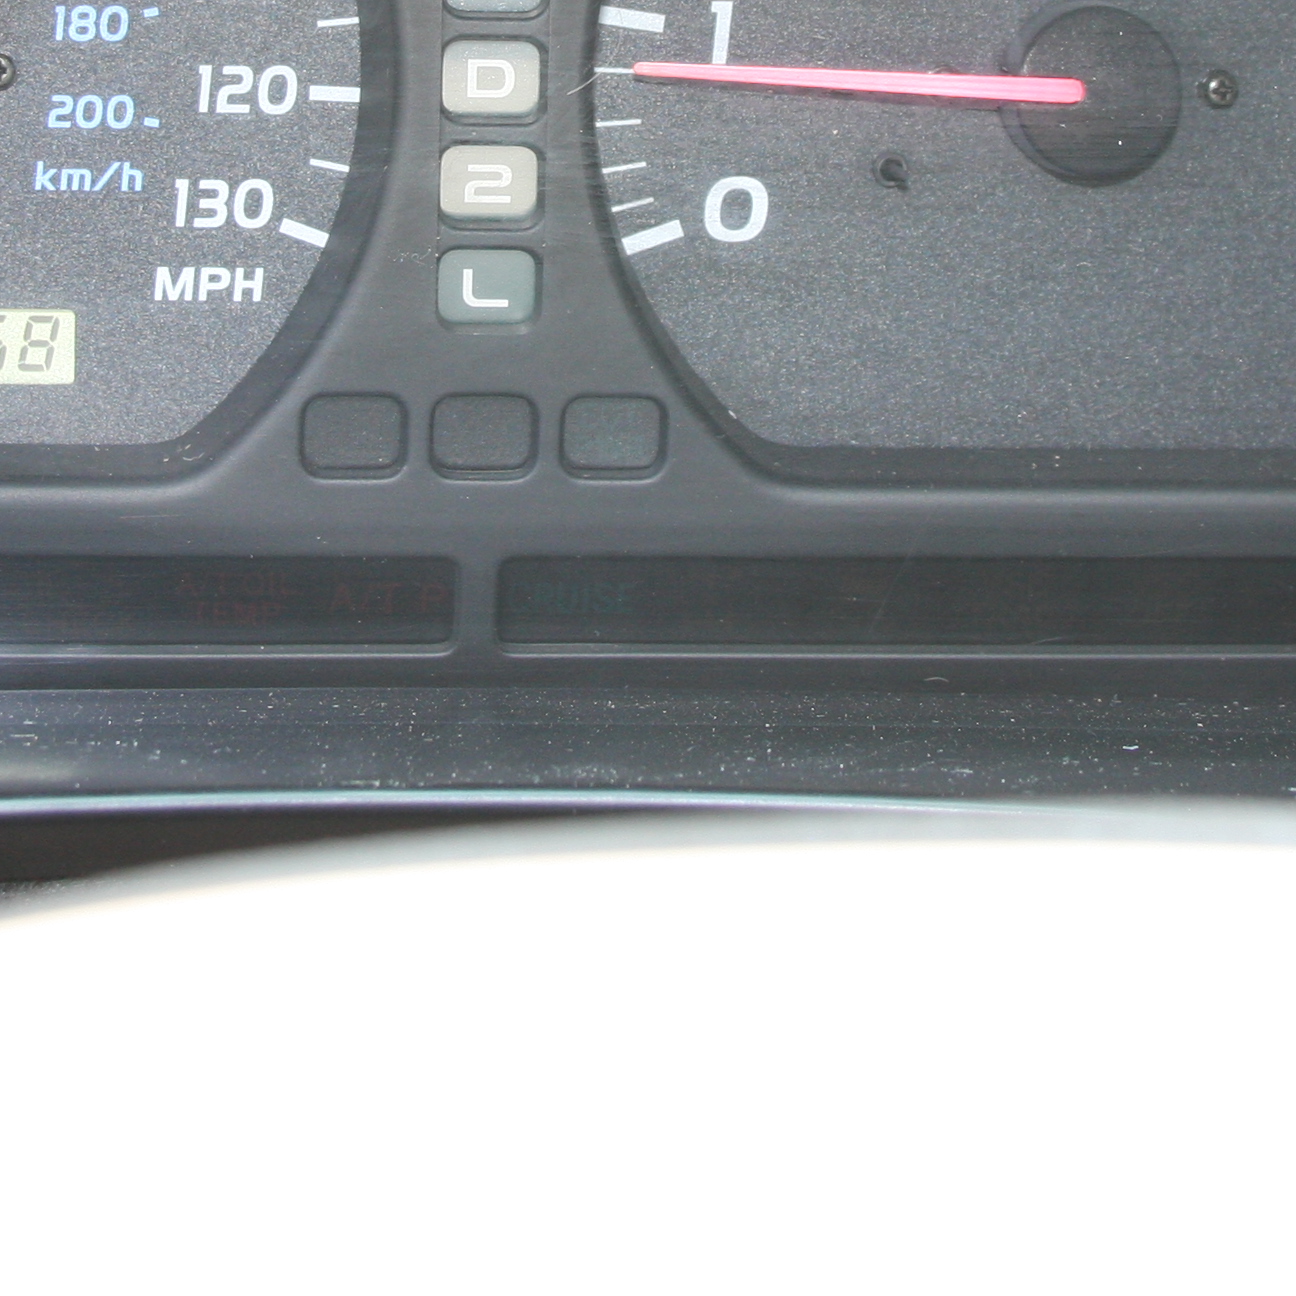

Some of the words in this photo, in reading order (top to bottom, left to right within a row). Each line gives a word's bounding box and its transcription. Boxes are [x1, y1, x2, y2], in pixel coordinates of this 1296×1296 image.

[55, 5, 128, 42] 180
[710, 0, 734, 66] 1
[198, 65, 297, 115] 120
[467, 60, 515, 98] D
[47, 95, 134, 129] 200
[33, 161, 143, 191] km/h
[465, 164, 512, 203] 2
[175, 179, 273, 229] 130
[704, 177, 768, 242] 0
[154, 267, 263, 302] MPH
[463, 269, 508, 307] L
